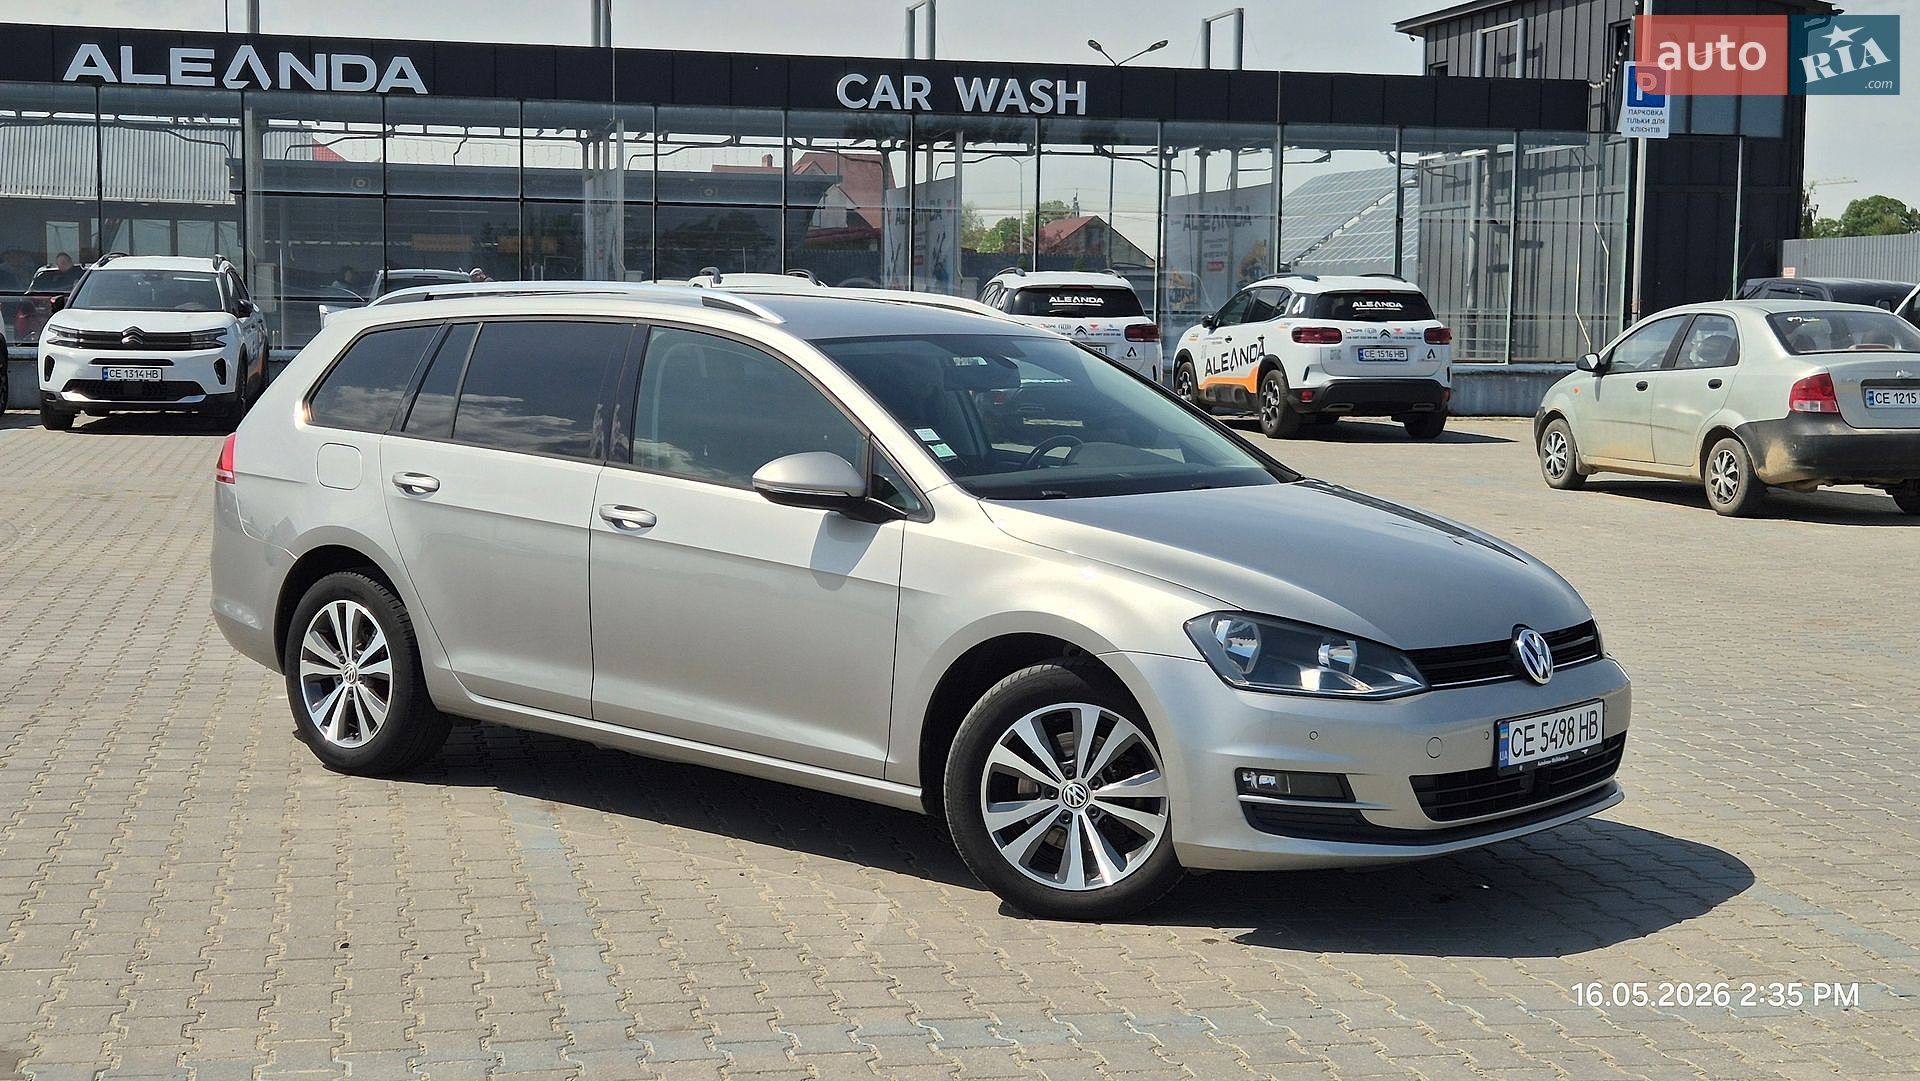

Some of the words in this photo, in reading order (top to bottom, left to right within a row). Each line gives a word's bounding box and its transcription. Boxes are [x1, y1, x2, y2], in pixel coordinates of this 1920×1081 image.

[62, 43, 429, 95] ALEANDA
[836, 73, 932, 112] CAR
[953, 76, 1087, 115] WASH
[1628, 109, 1664, 117] ПАРКОВКА
[1627, 117, 1650, 125] ТІЛЬКИ
[1204, 341, 1266, 378] ALEANDA
[1364, 350, 1375, 358] CE
[1377, 350, 1393, 358] 1516
[109, 369, 121, 378] CE
[124, 369, 144, 379] 1314
[145, 370, 159, 379] HB
[1875, 392, 1890, 404] CE
[1893, 392, 1917, 404] 1215
[1511, 723, 1536, 758] CE
[1540, 716, 1575, 752] 5498
[1579, 709, 1598, 743] HB
